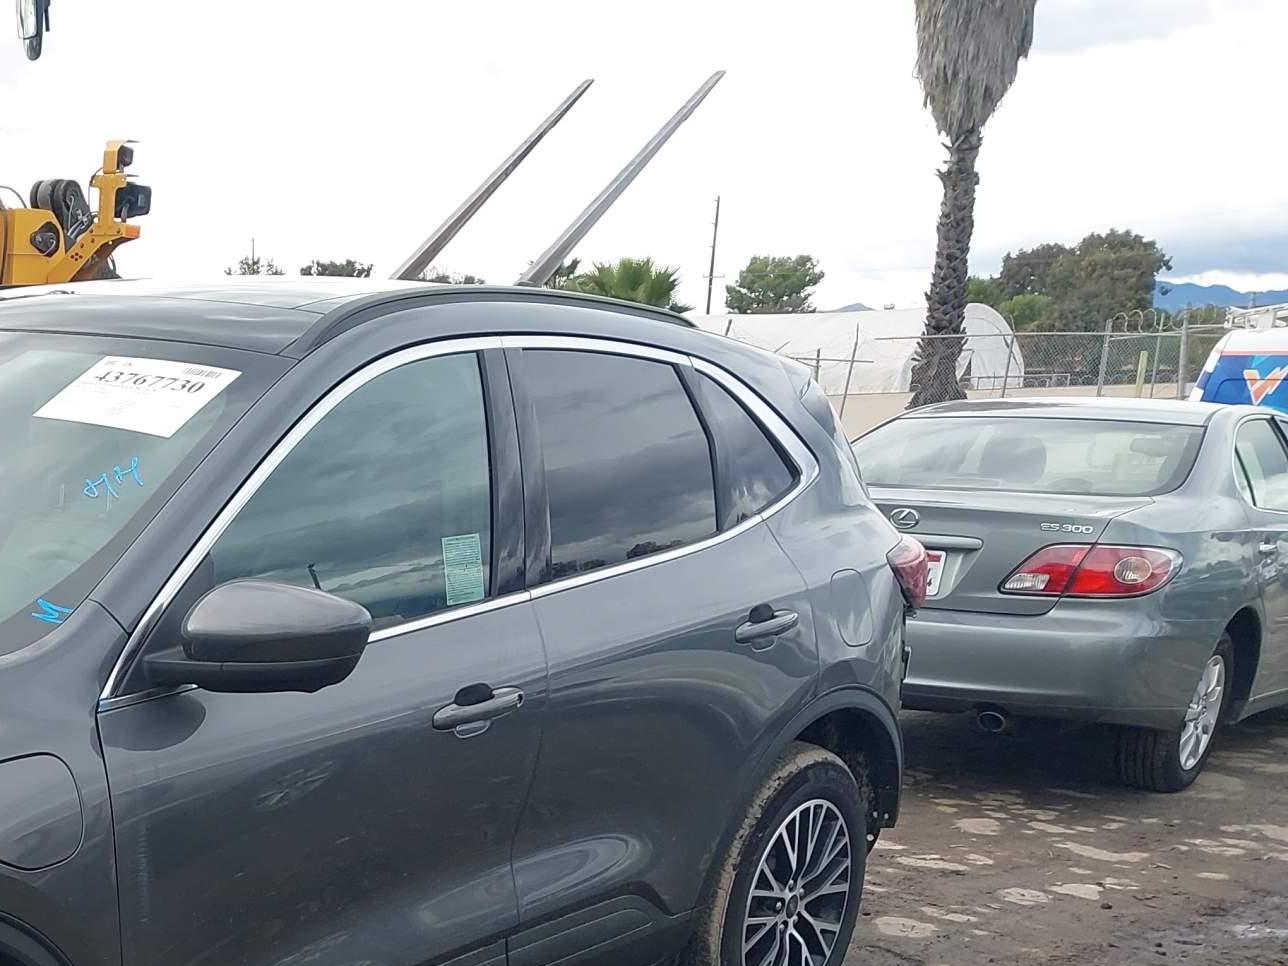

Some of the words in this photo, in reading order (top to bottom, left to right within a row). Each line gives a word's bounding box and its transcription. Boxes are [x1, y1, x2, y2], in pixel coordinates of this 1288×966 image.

[95, 370, 206, 394] 43767730
[1040, 522, 1060, 532] ES
[1062, 524, 1094, 534] 300
